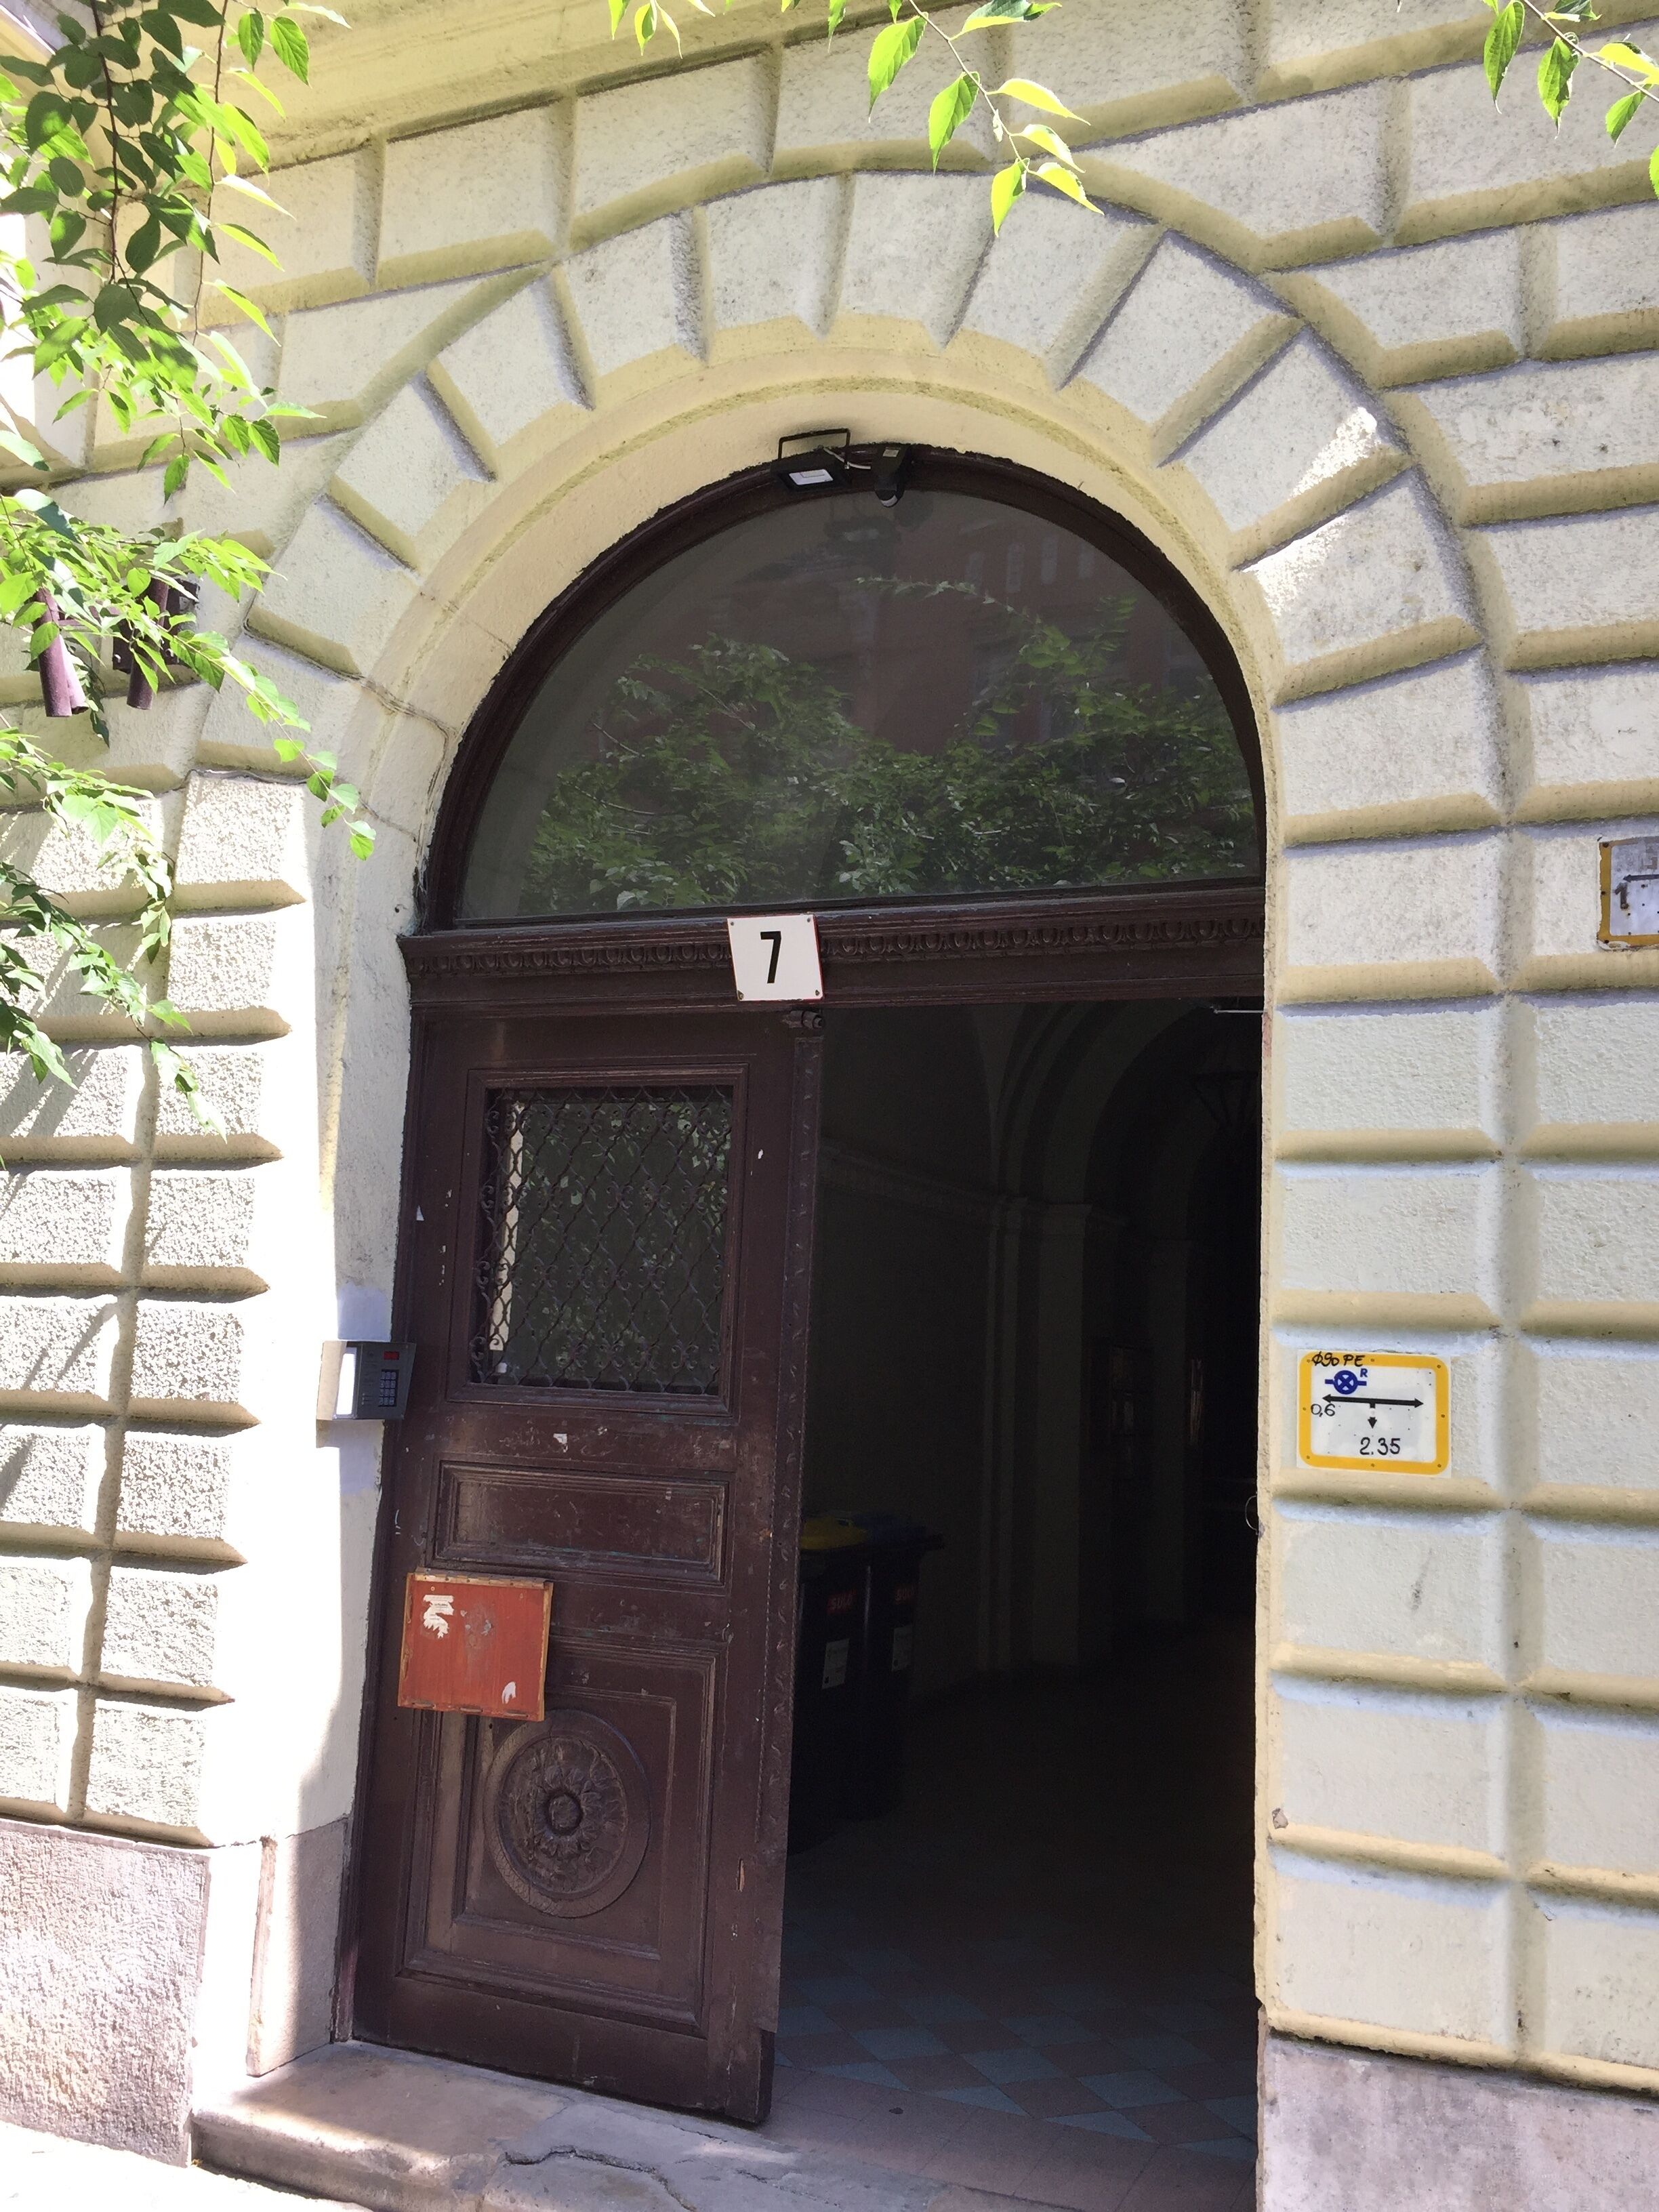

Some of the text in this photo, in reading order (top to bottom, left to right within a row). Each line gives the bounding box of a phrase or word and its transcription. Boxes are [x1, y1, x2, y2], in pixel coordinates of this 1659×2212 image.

[760, 930, 781, 983] 7
[1344, 1355, 1366, 1367] PE
[1359, 1368, 1368, 1377] R
[1359, 1437, 1401, 1456] 2.35
